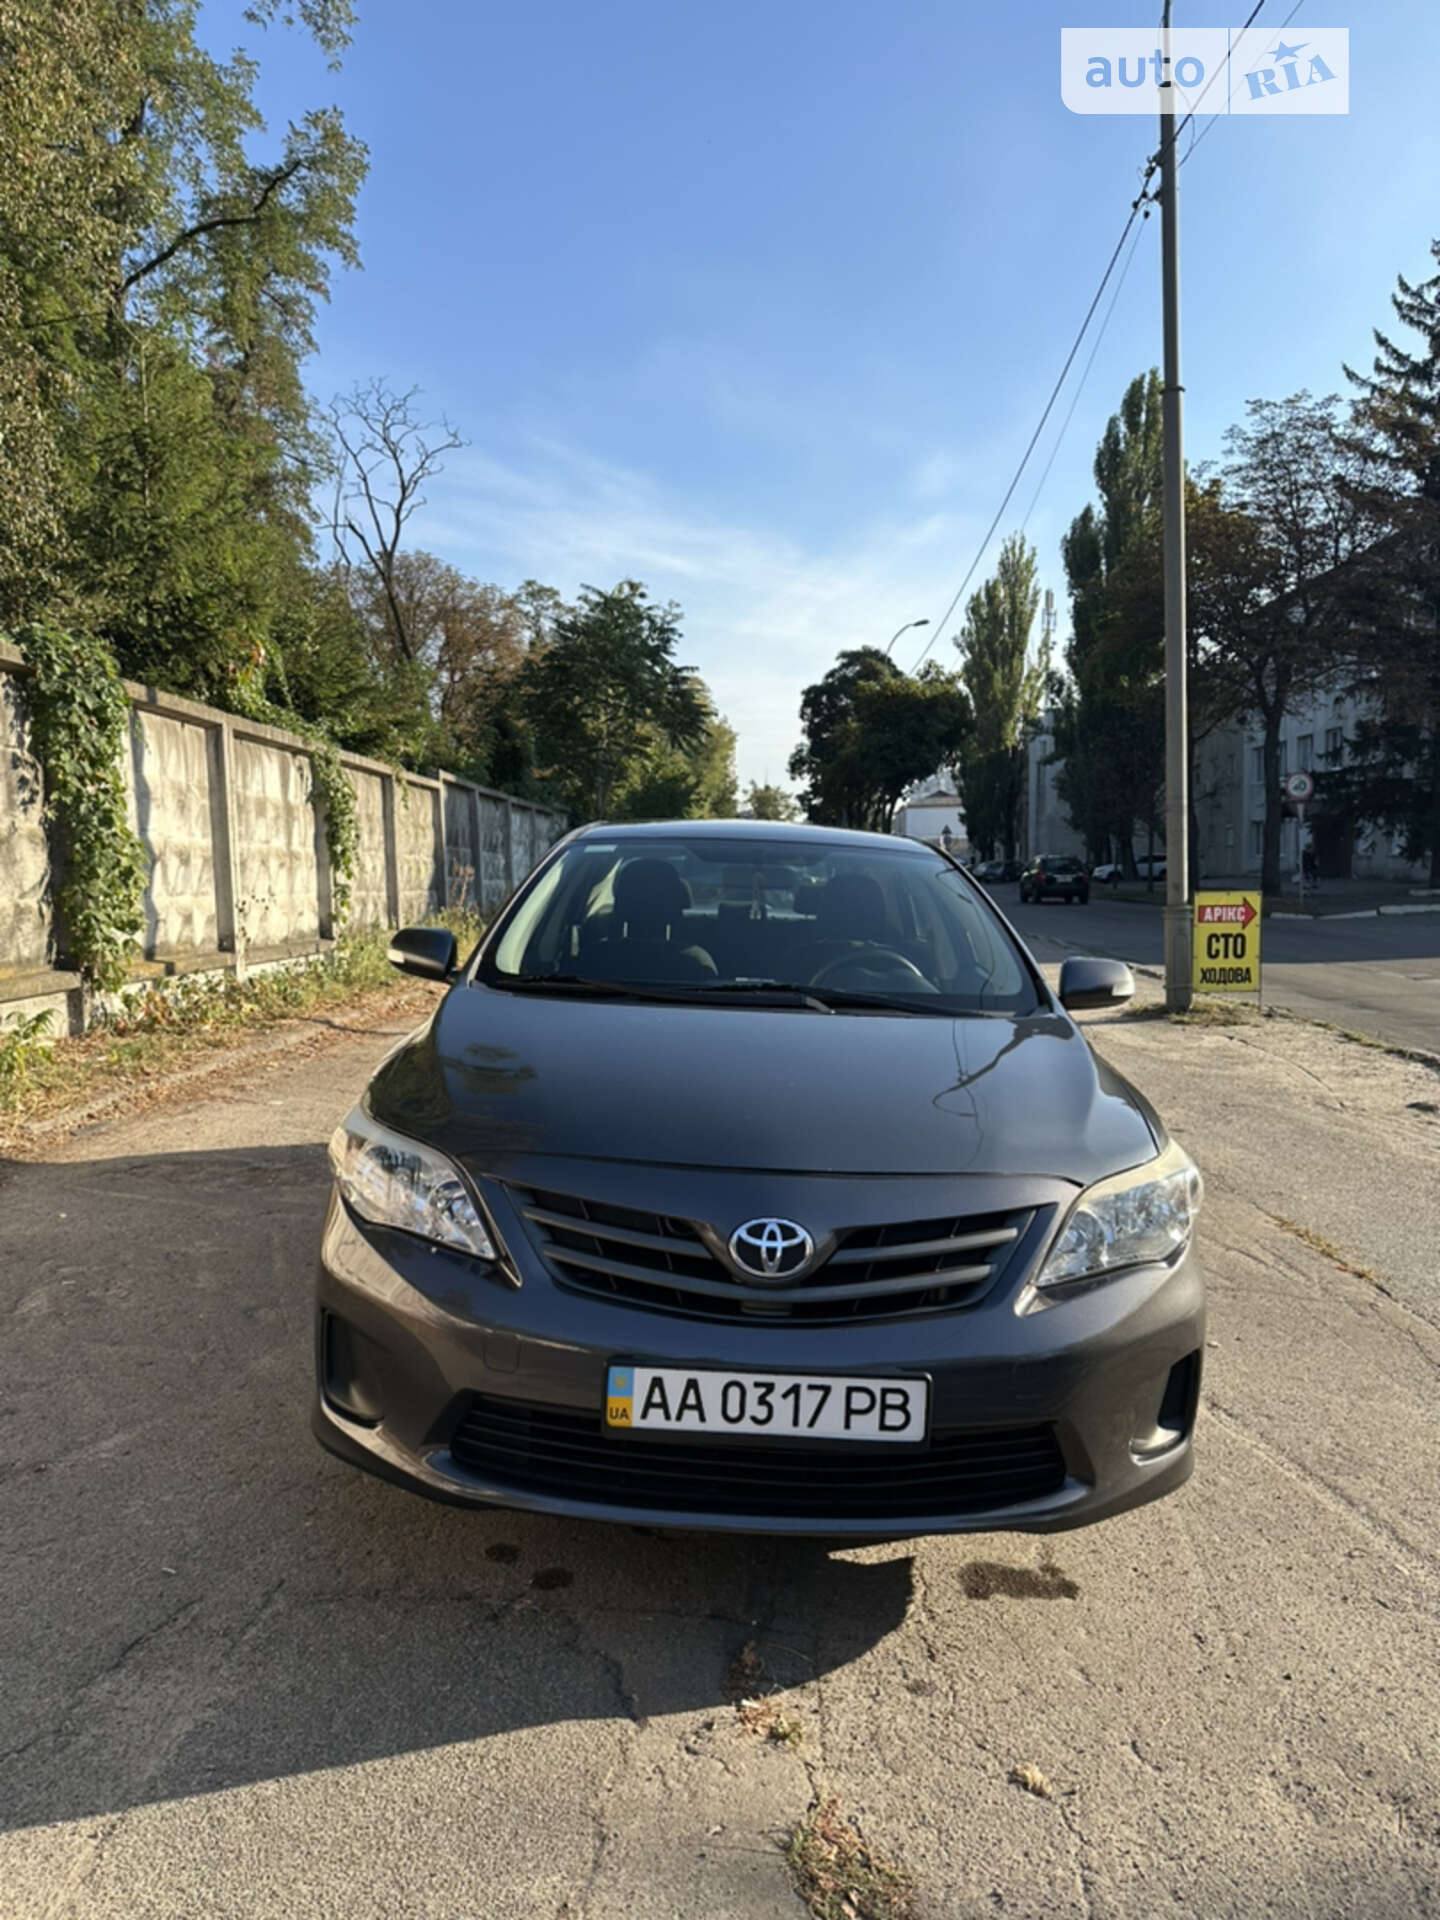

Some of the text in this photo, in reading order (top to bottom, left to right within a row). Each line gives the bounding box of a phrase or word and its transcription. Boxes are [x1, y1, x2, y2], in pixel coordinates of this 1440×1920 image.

[1203, 906, 1246, 922] АРІКС
[1207, 932, 1246, 959] СТО
[1200, 966, 1252, 985] ХОДОВА
[640, 1376, 706, 1423] AA
[721, 1380, 832, 1428] 0317
[609, 1406, 629, 1421] UA
